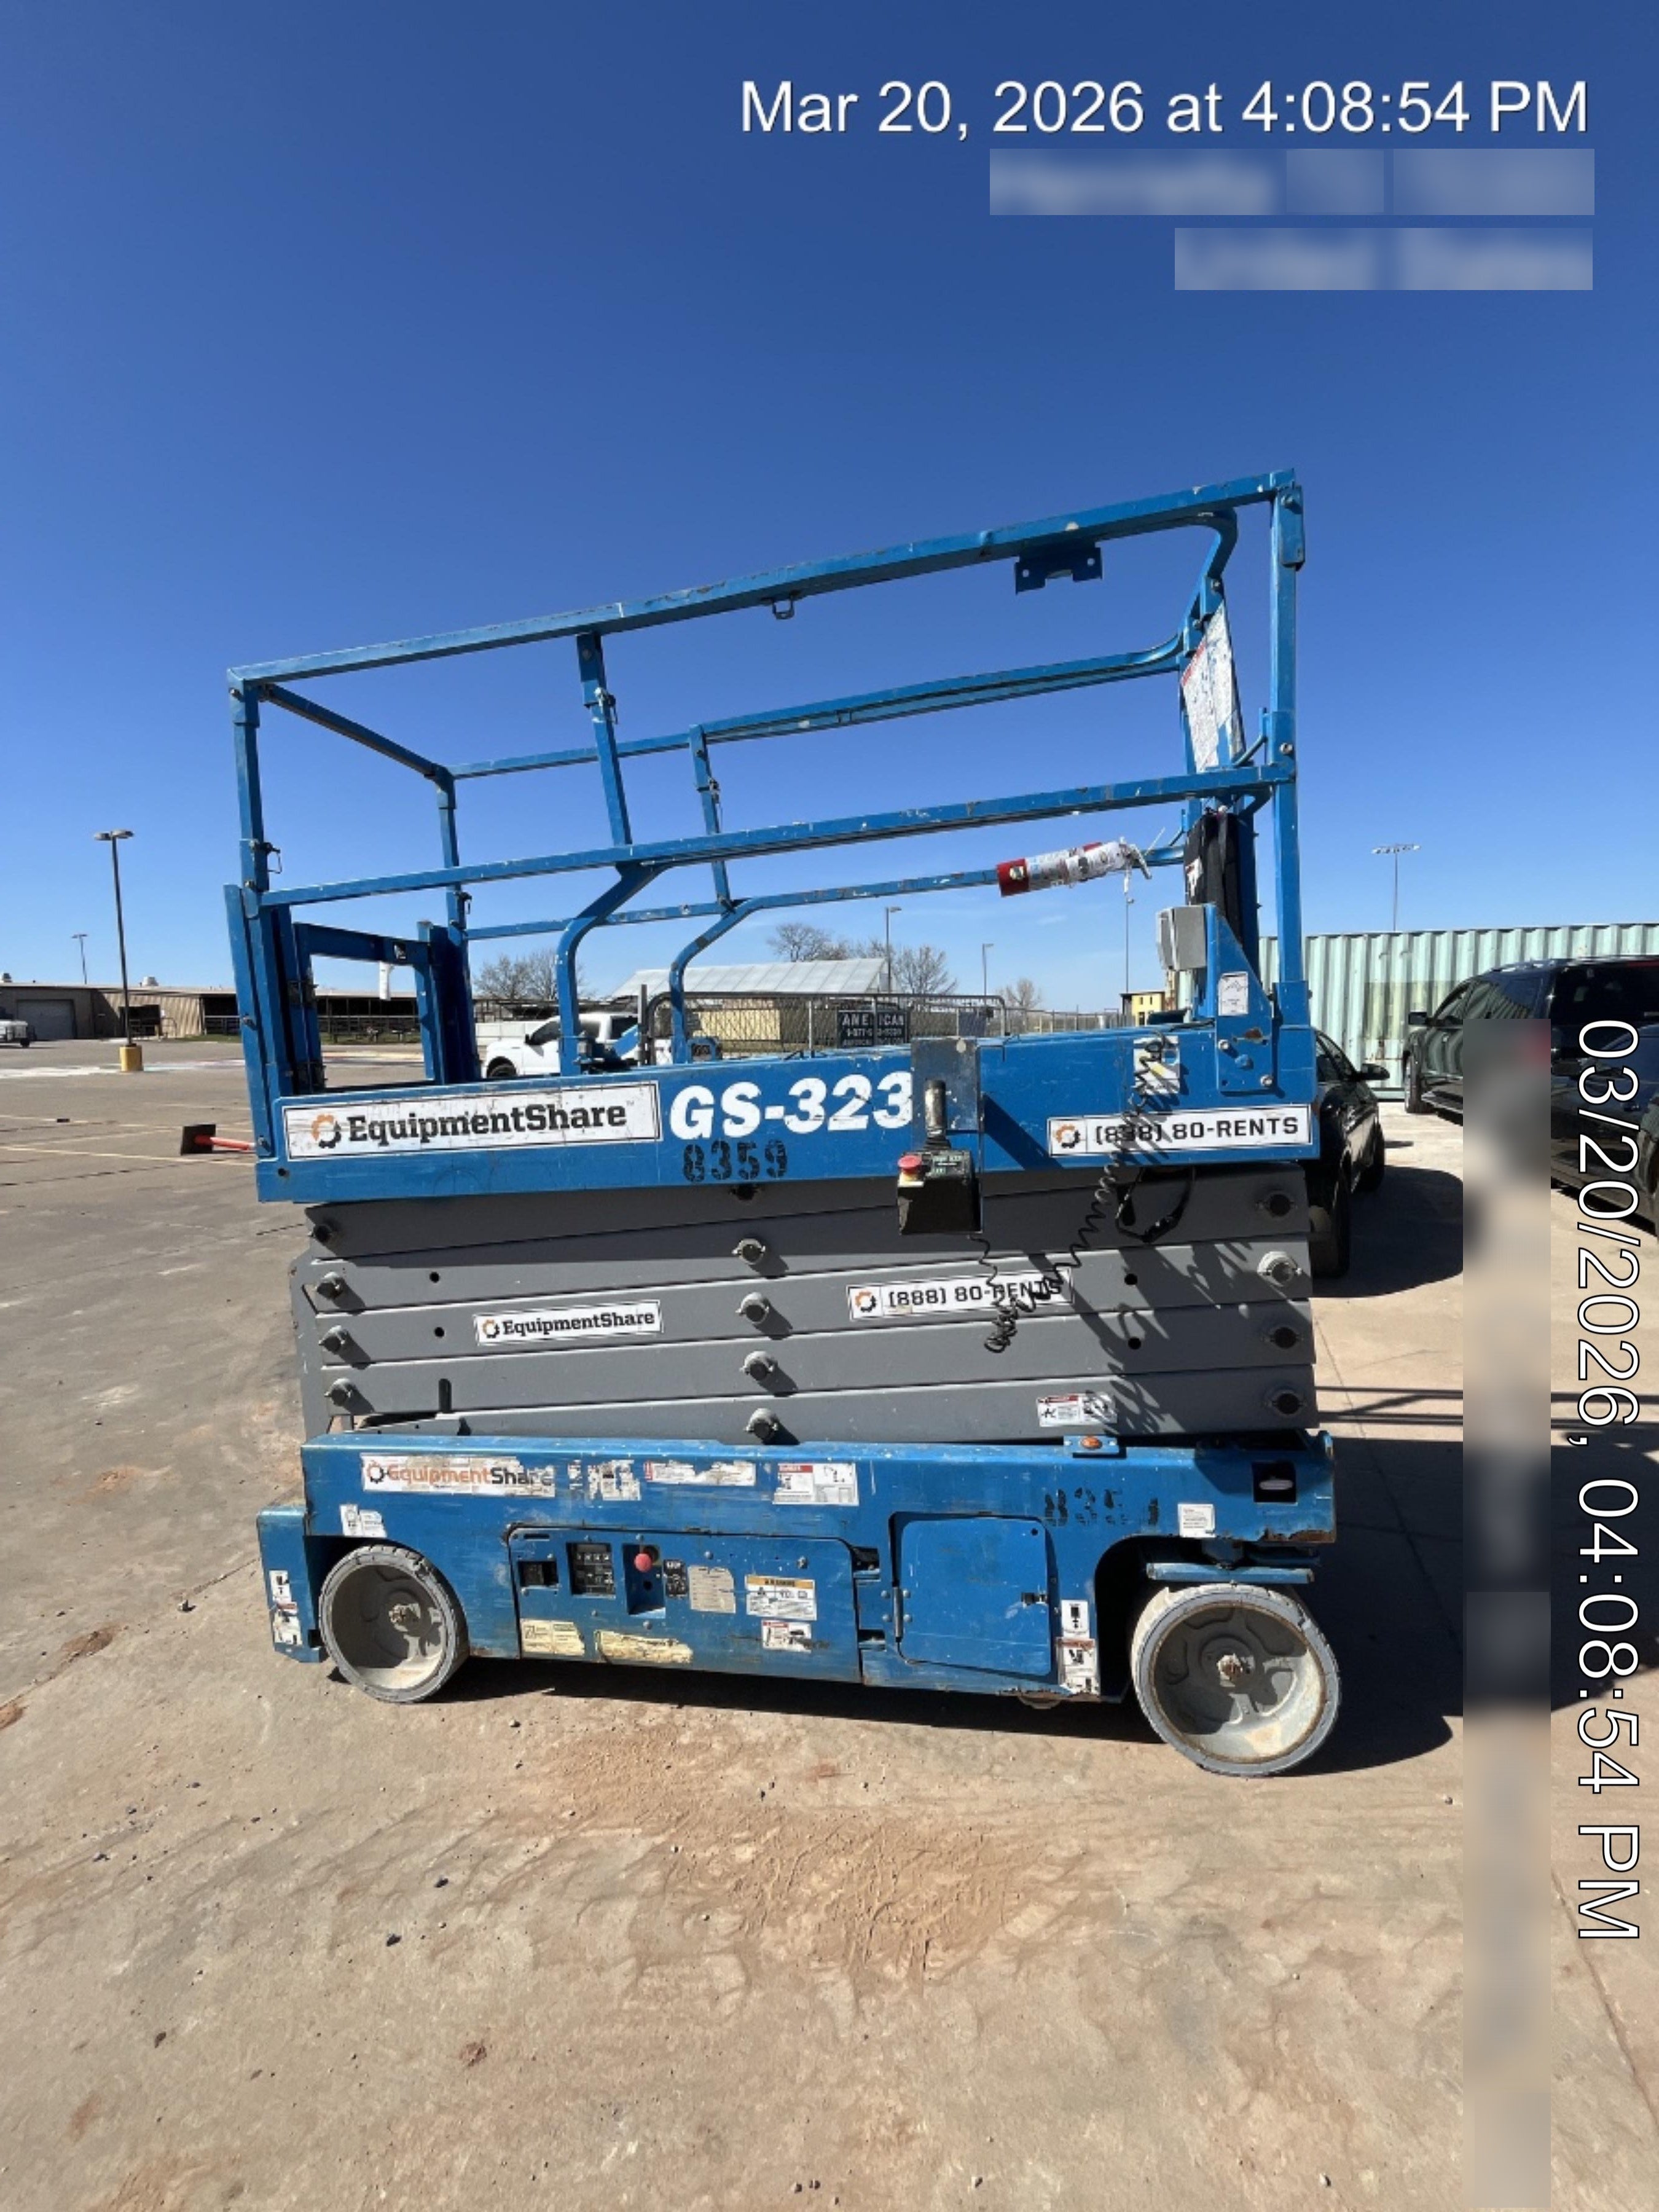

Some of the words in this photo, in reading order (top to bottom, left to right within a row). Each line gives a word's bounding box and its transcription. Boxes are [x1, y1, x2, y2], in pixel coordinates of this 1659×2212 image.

[842, 1013, 904, 1026] AMEICAN
[347, 1104, 626, 1144] EquipmentShare
[1172, 1116, 1299, 1141] 80-RENTS
[683, 1139, 788, 1182] 8359
[888, 1288, 947, 1308] (888)
[502, 1312, 655, 1335] EquipmentShare
